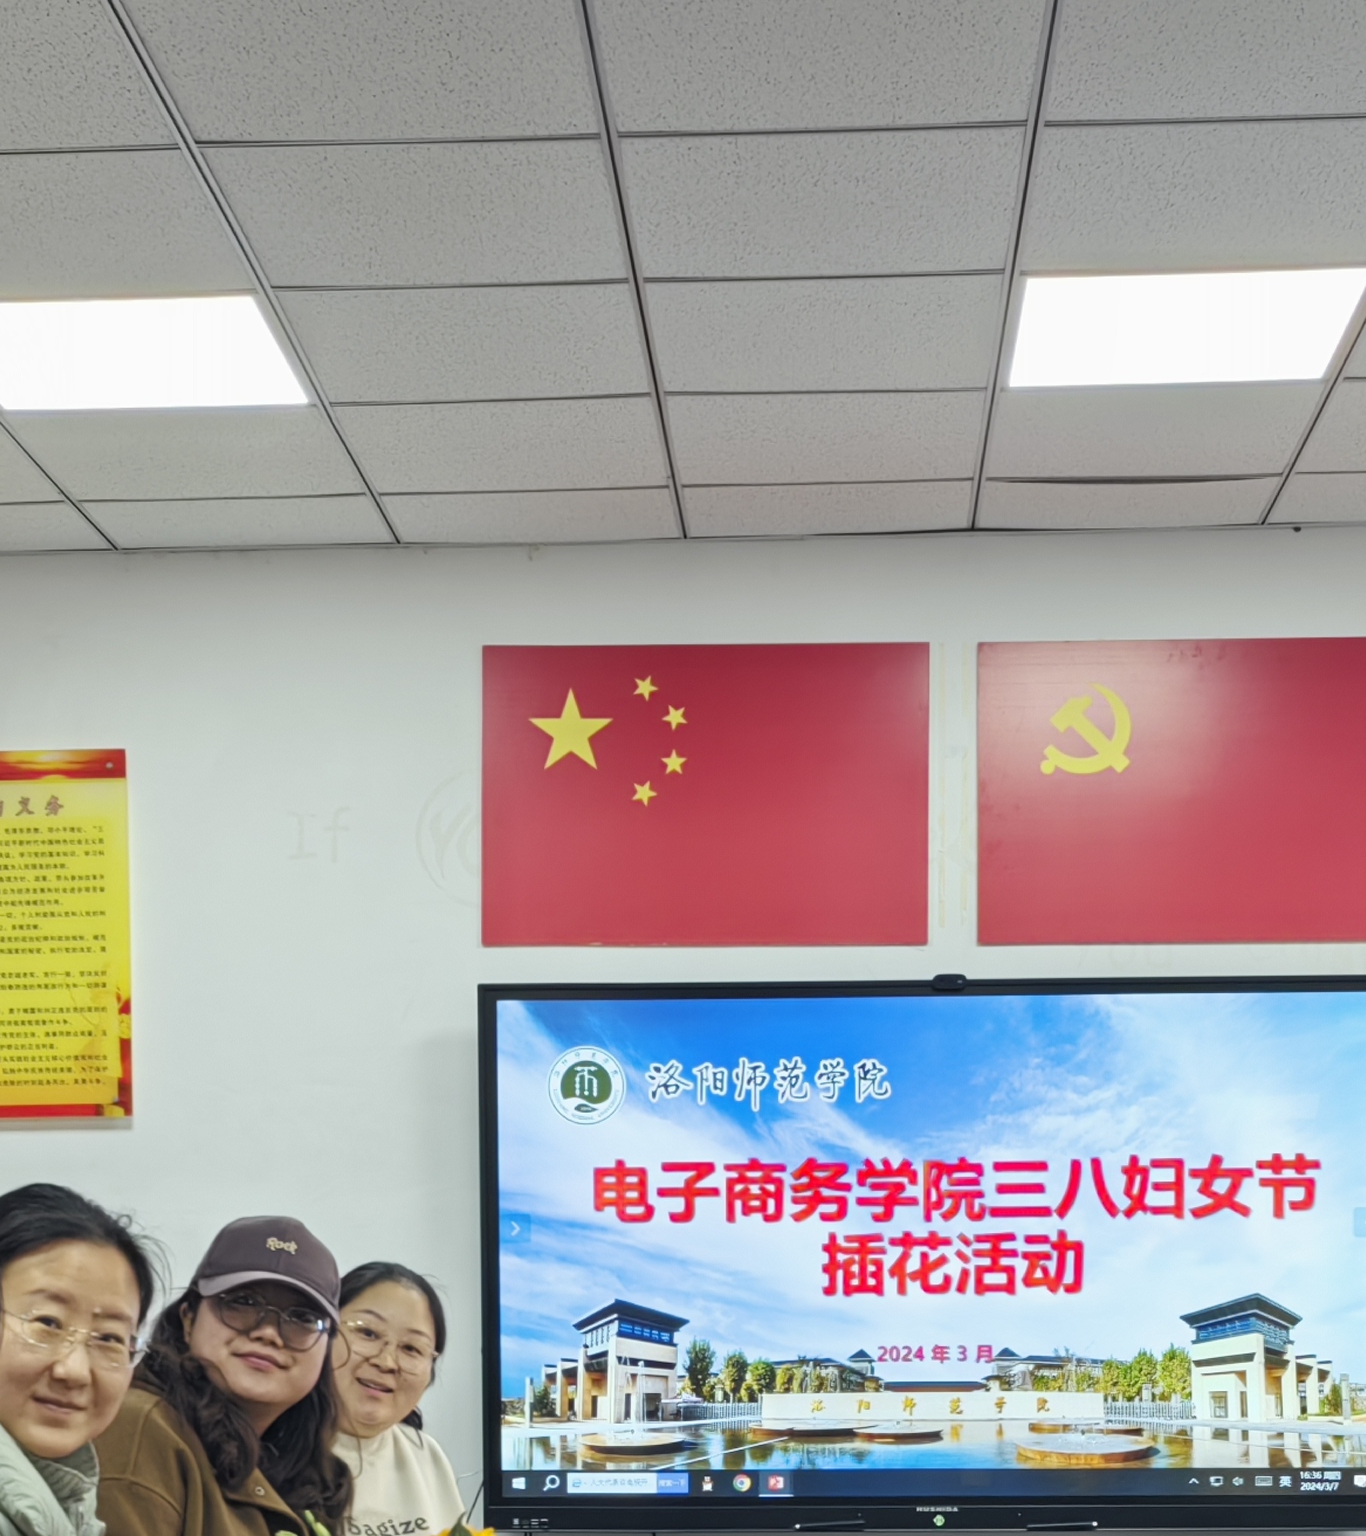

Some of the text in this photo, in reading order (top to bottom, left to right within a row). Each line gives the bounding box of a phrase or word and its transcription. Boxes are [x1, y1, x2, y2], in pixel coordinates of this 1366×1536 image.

[644, 1056, 892, 1112] 洛阳师范学院
[591, 1154, 1321, 1224] 电子商务学院三八妇女节
[821, 1232, 1086, 1297] 插花活动
[1279, 1476, 1292, 1487] 英
[1300, 1482, 1339, 1491] 2024/3/7
